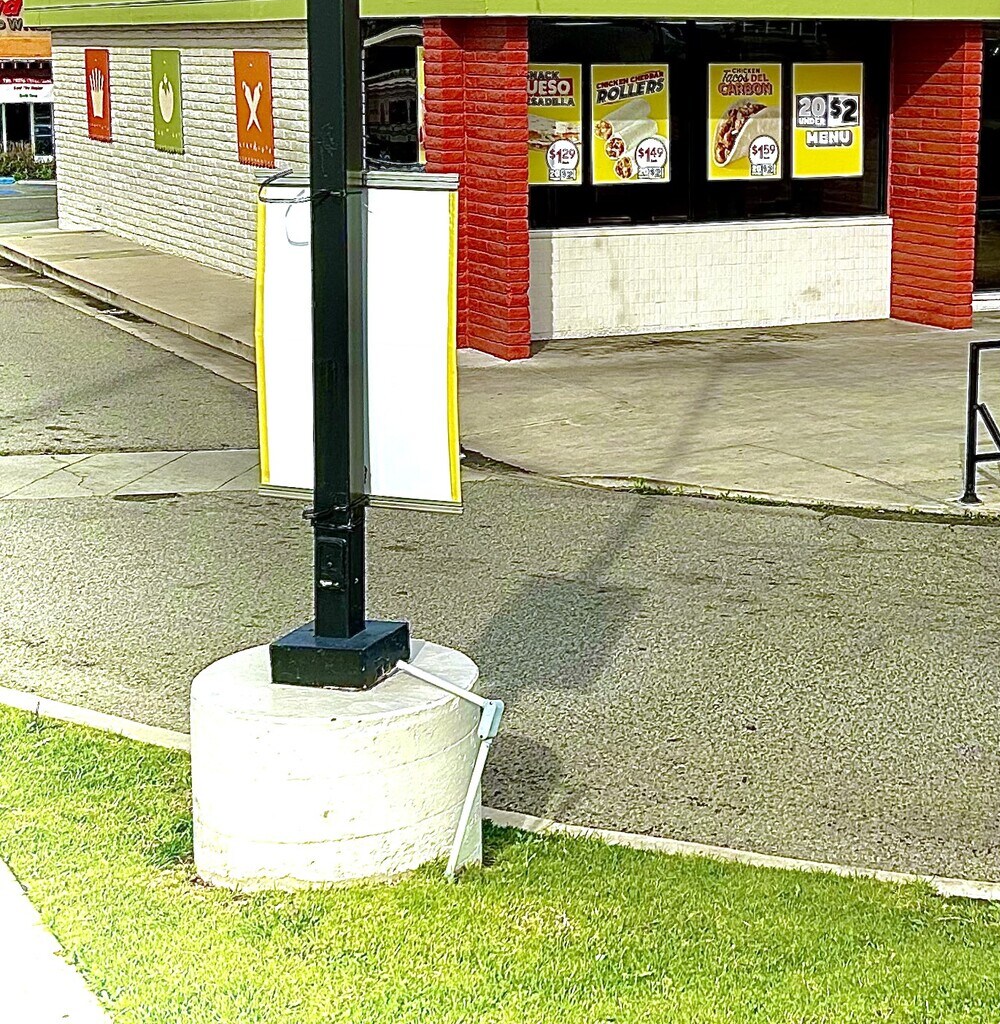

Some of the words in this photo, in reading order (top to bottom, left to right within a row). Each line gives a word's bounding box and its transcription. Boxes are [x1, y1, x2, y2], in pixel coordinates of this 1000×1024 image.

[527, 71, 560, 80] NACK
[751, 73, 769, 82] DEL
[527, 80, 571, 95] UESO
[597, 78, 628, 89] CHICKEN
[717, 82, 773, 96] CARBON
[596, 78, 664, 103] ROLLERS
[527, 97, 575, 106] SADILLA
[798, 97, 826, 117] 20
[830, 97, 857, 123] $2
[798, 118, 827, 126] UNDER
[806, 130, 852, 146] MENU
